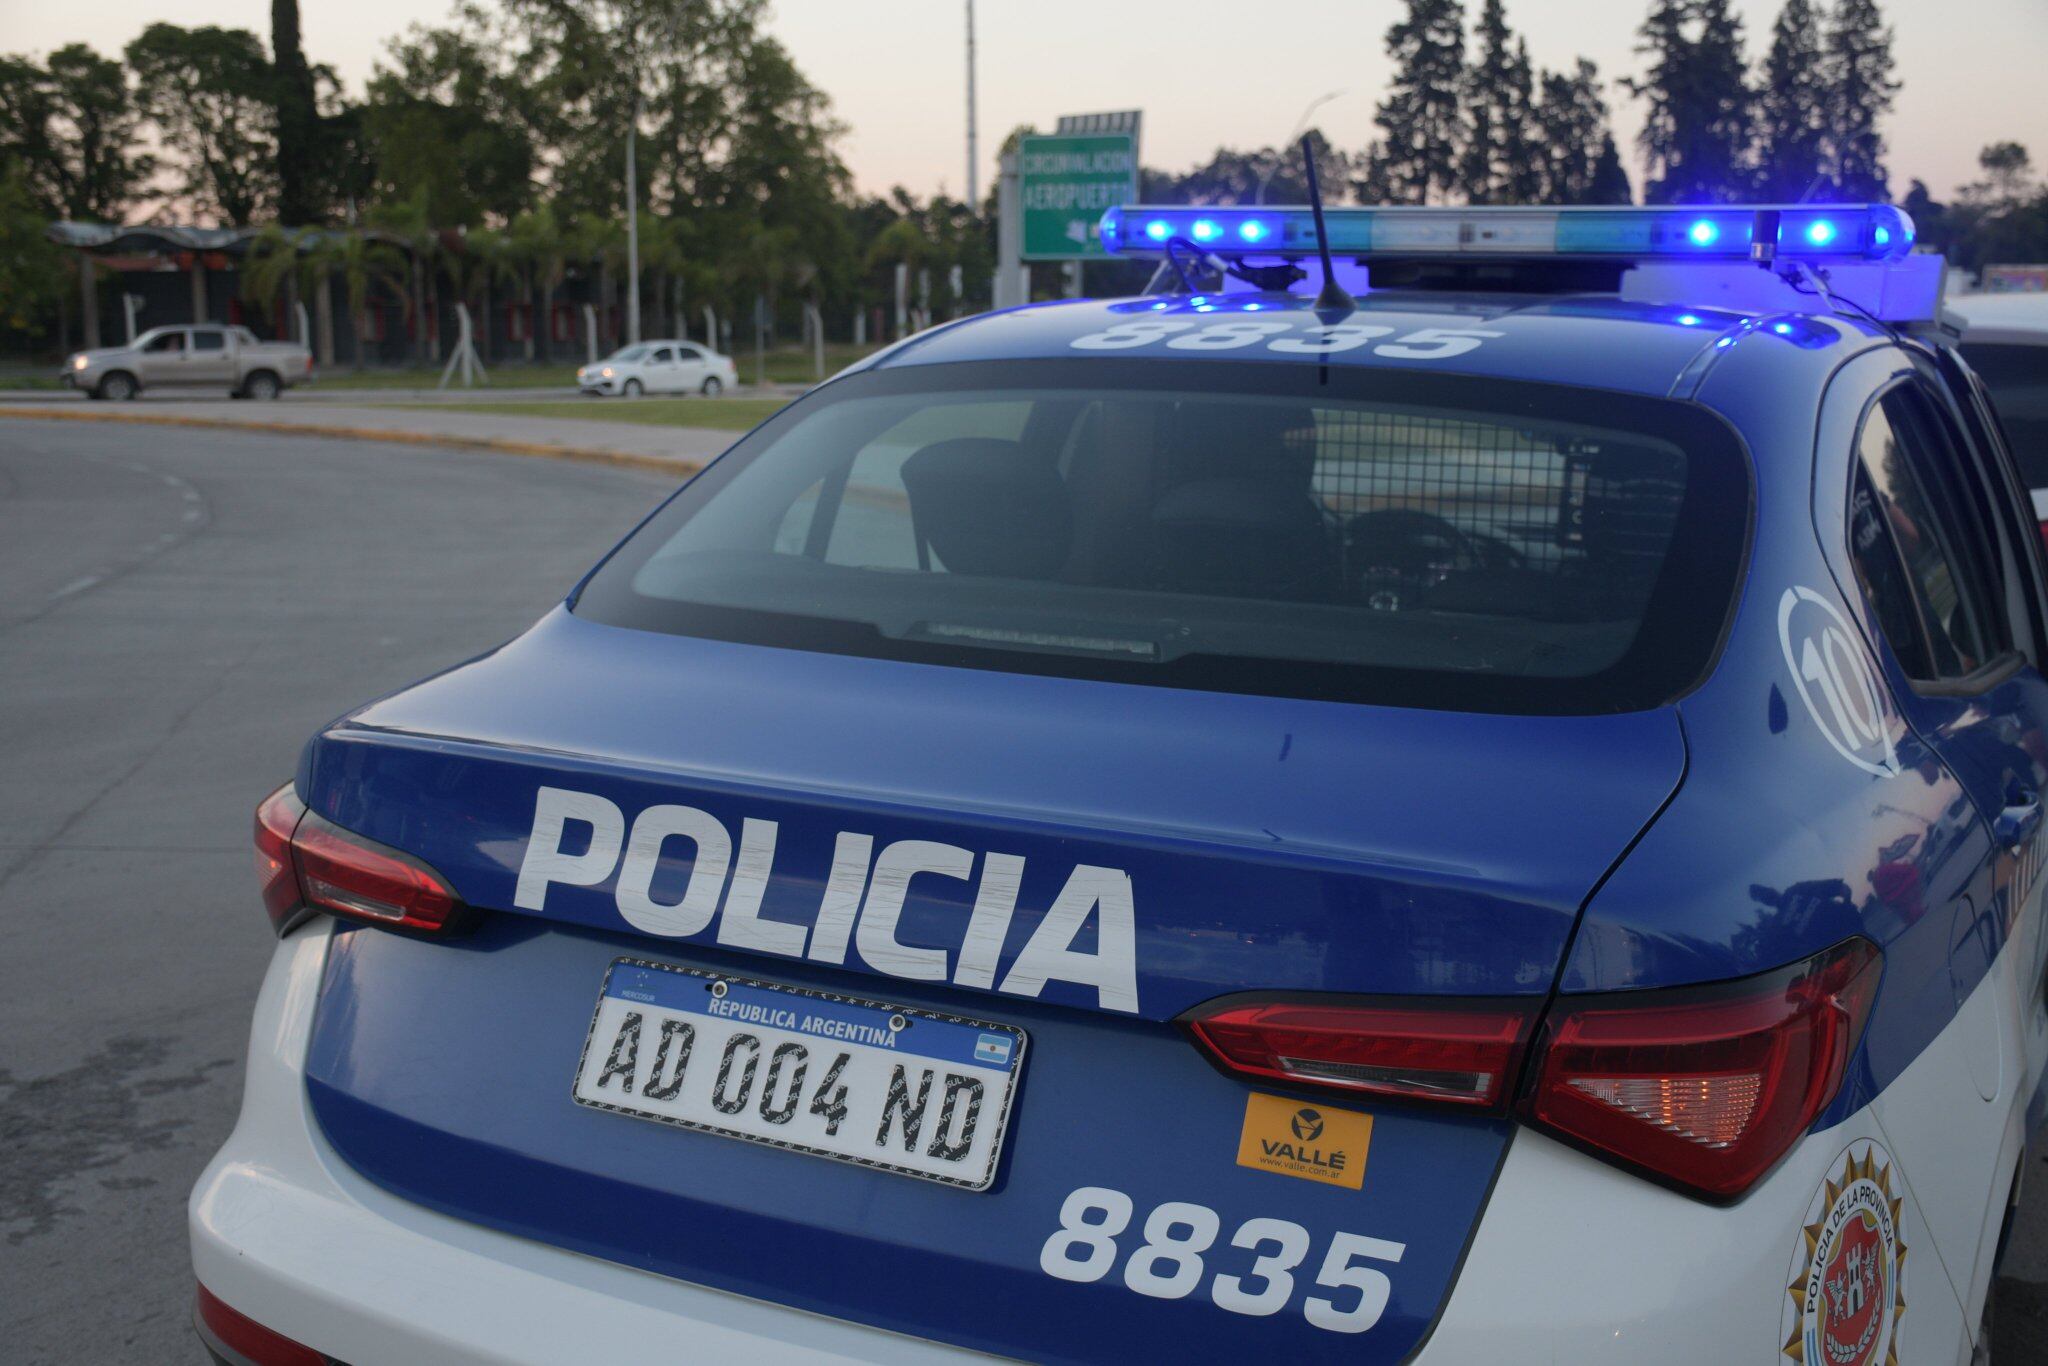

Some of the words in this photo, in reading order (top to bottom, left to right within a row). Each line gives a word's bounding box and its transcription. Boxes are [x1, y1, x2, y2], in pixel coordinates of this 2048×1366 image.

[1069, 321, 1505, 359] 8835
[1801, 626, 1880, 751] 10
[514, 786, 1139, 1014] POLICIA
[621, 990, 656, 1002] MERCOSUR
[708, 998, 796, 1029] REPUBLICA
[800, 1015, 896, 1048] ARGENTINA
[597, 1011, 696, 1102] AD
[711, 1033, 851, 1137] 004
[875, 1064, 984, 1162] ND
[1259, 1157, 1341, 1179] www.valle.com.ar
[1261, 1138, 1346, 1170] VALLÉ
[1039, 1186, 1407, 1334] 8835
[1806, 1228, 1834, 1313] POLICIA
[1832, 1203, 1847, 1228] DE
[1846, 1188, 1859, 1209] LA
[1859, 1185, 1893, 1251] PROVINCIA
